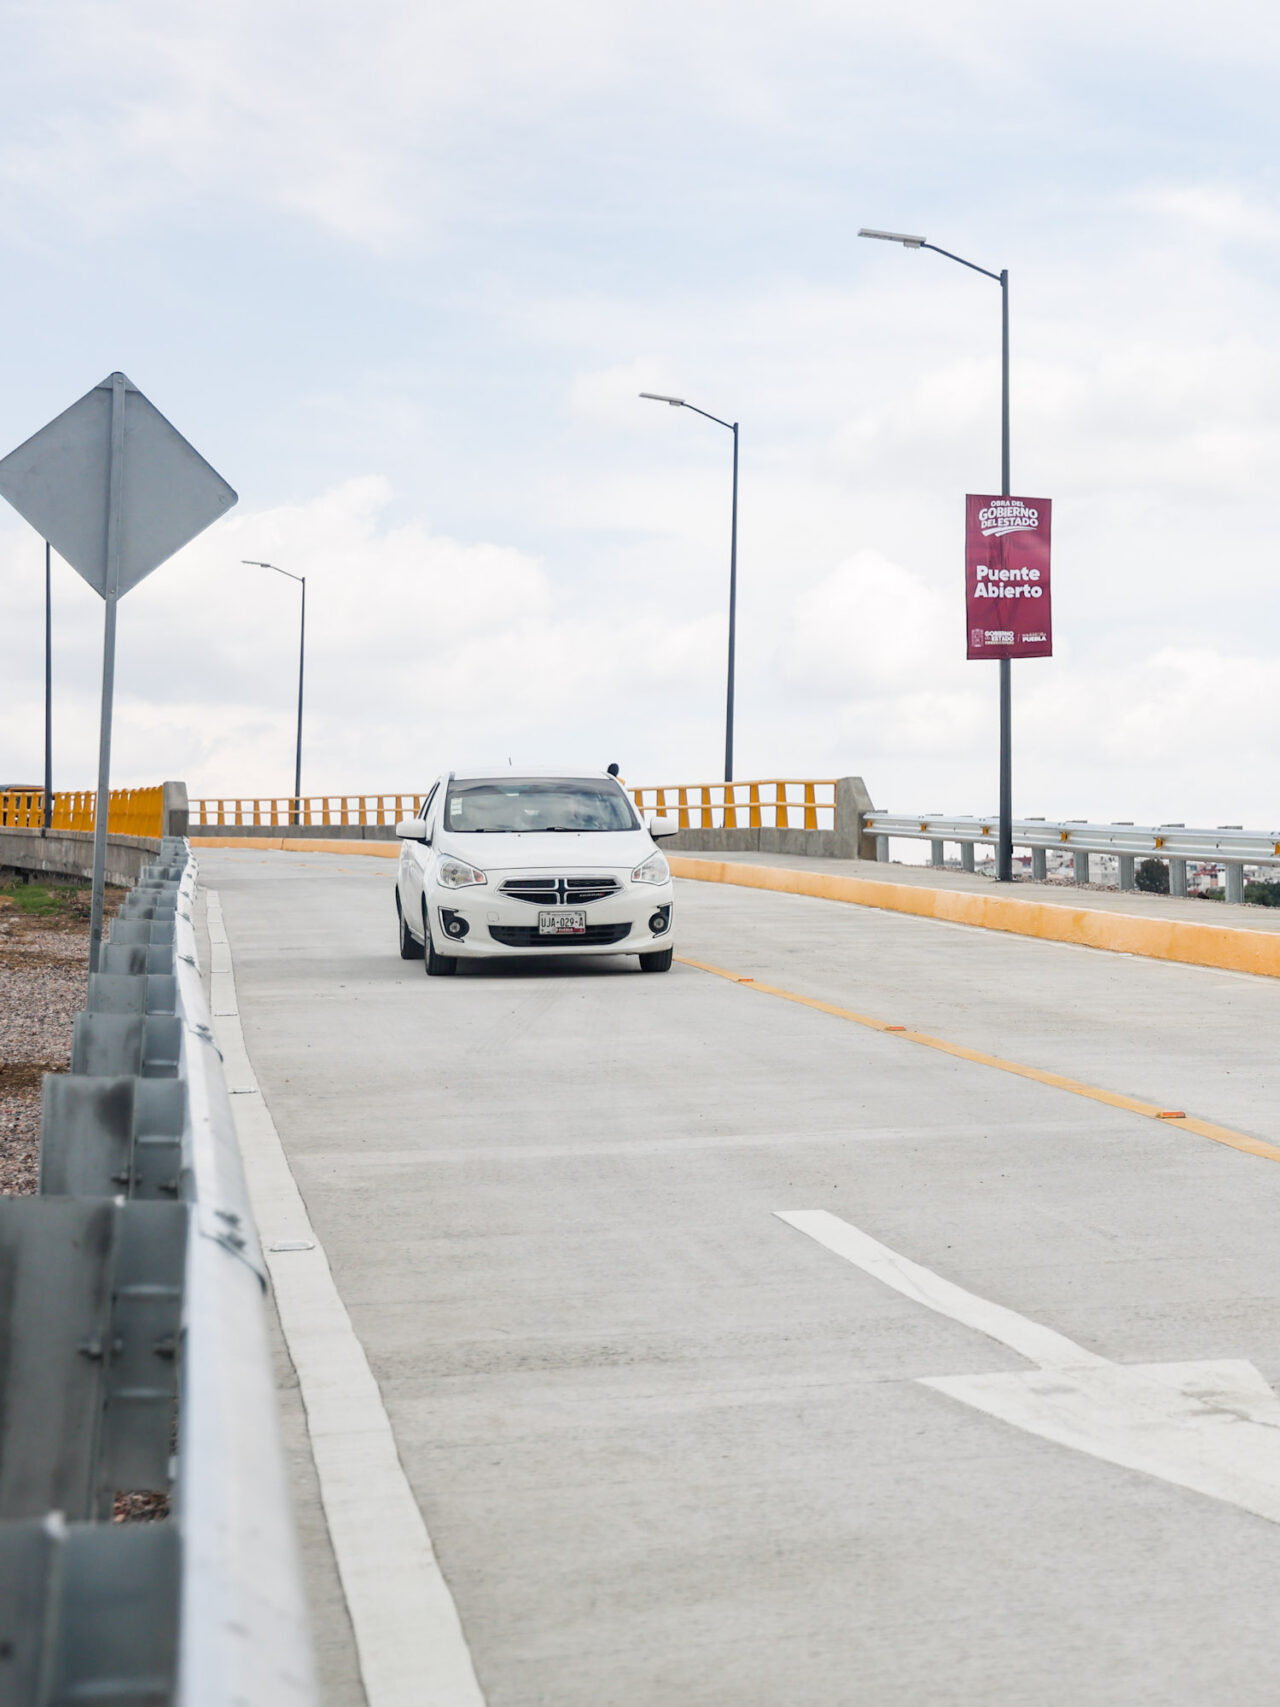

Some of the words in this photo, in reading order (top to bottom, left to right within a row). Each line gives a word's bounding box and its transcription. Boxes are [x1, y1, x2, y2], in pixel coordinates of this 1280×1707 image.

[978, 506, 1039, 521] GOBIERNO
[981, 518, 998, 529] DEL
[997, 517, 1039, 527] ESTADO
[976, 565, 1041, 581] Puente
[973, 581, 1043, 598] Abierto
[541, 917, 584, 928] UJA-029-A
